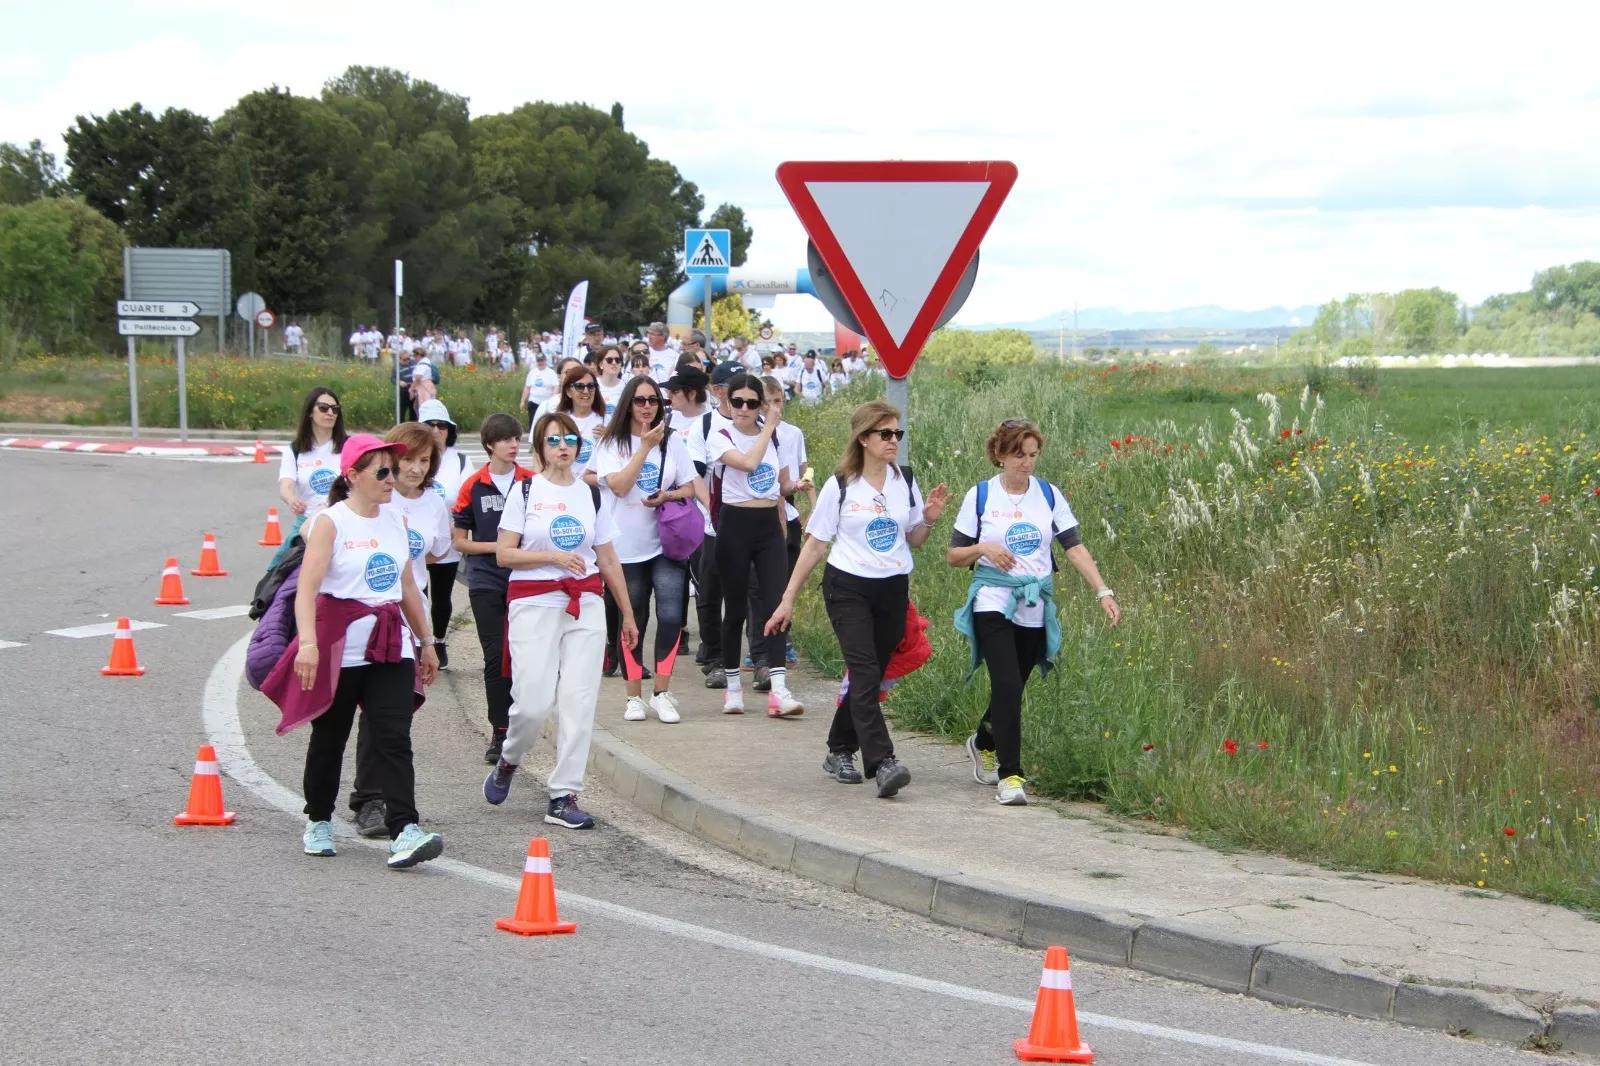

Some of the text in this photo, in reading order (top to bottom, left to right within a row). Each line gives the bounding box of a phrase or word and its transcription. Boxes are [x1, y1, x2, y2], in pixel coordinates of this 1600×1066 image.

[747, 280, 790, 289] CaixaBank
[121, 304, 189, 313] CUARTE 3
[534, 503, 543, 511] 12
[851, 503, 860, 512] 12
[991, 510, 1000, 518] 12
[343, 540, 355, 550] 12
